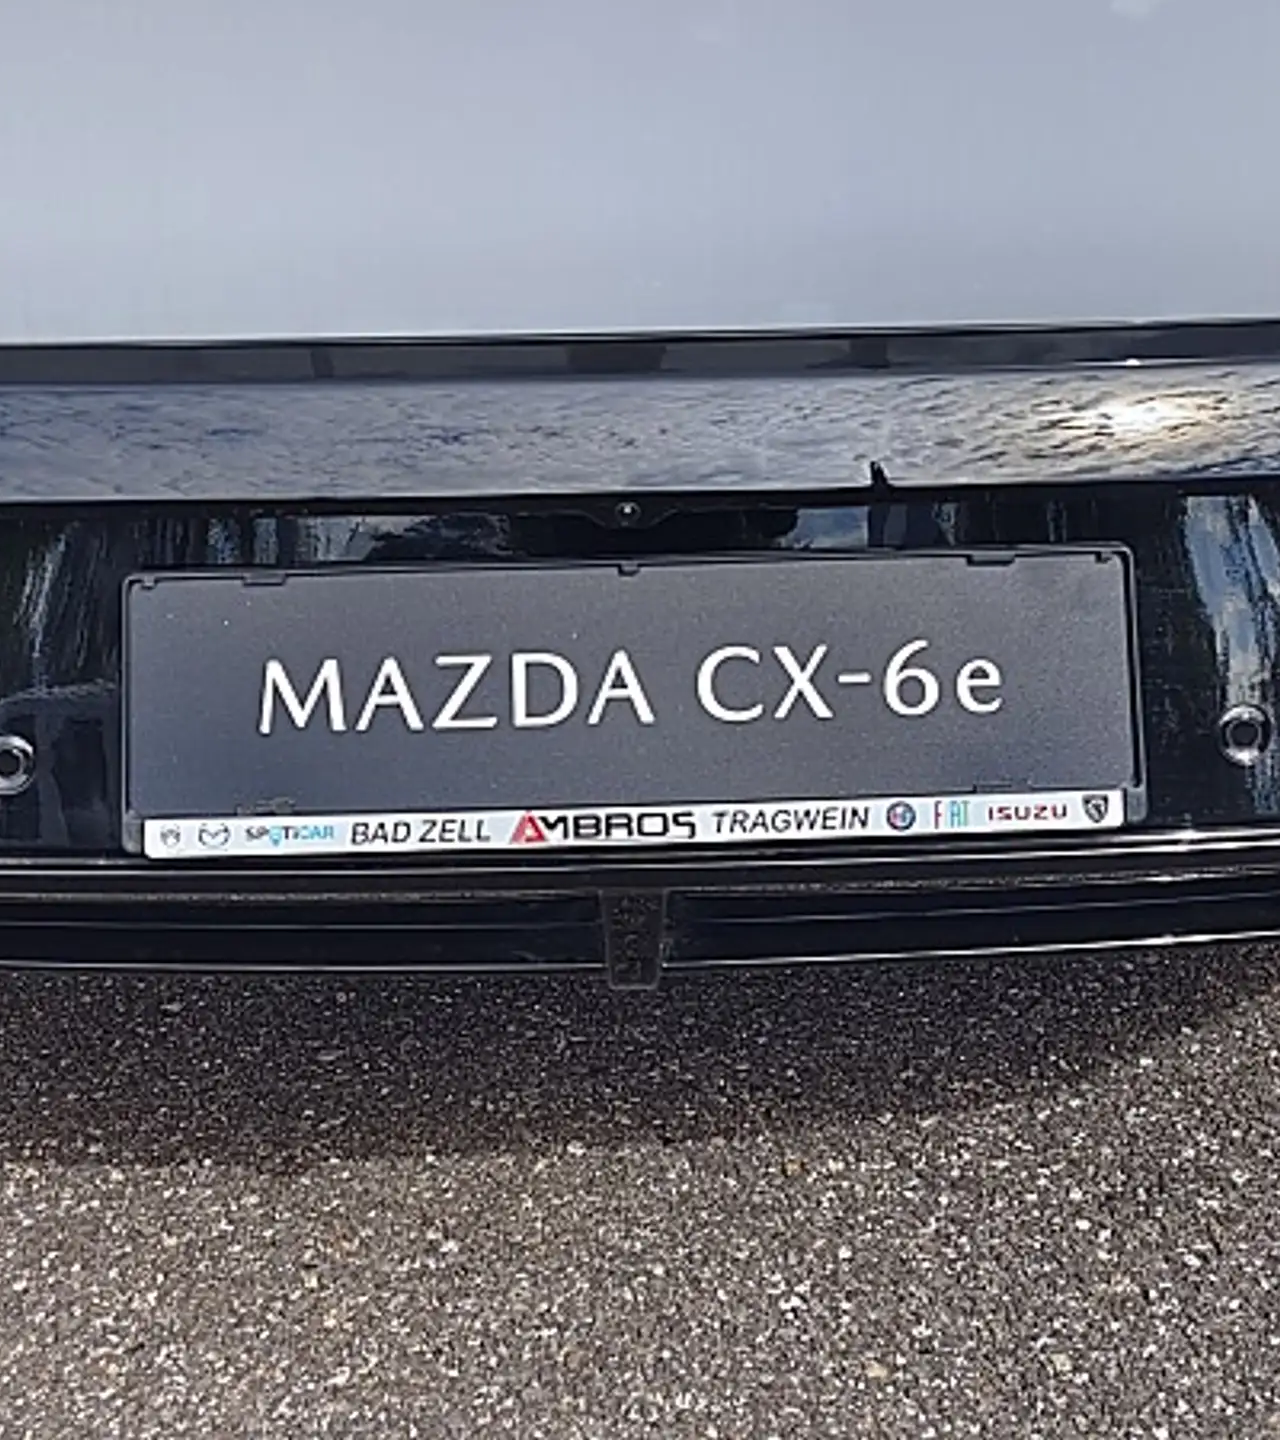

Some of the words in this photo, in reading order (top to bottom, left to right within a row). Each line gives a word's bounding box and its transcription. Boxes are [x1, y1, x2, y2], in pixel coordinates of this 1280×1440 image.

[258, 650, 656, 735] MAZDA
[696, 639, 1004, 723] CX-6e
[351, 821, 412, 846] BAD
[420, 819, 490, 843] ZELL
[509, 809, 696, 845] AMBROS
[712, 807, 869, 834] TRAGWEIN
[933, 800, 970, 829] FAT
[988, 804, 1068, 821] ISUZU
